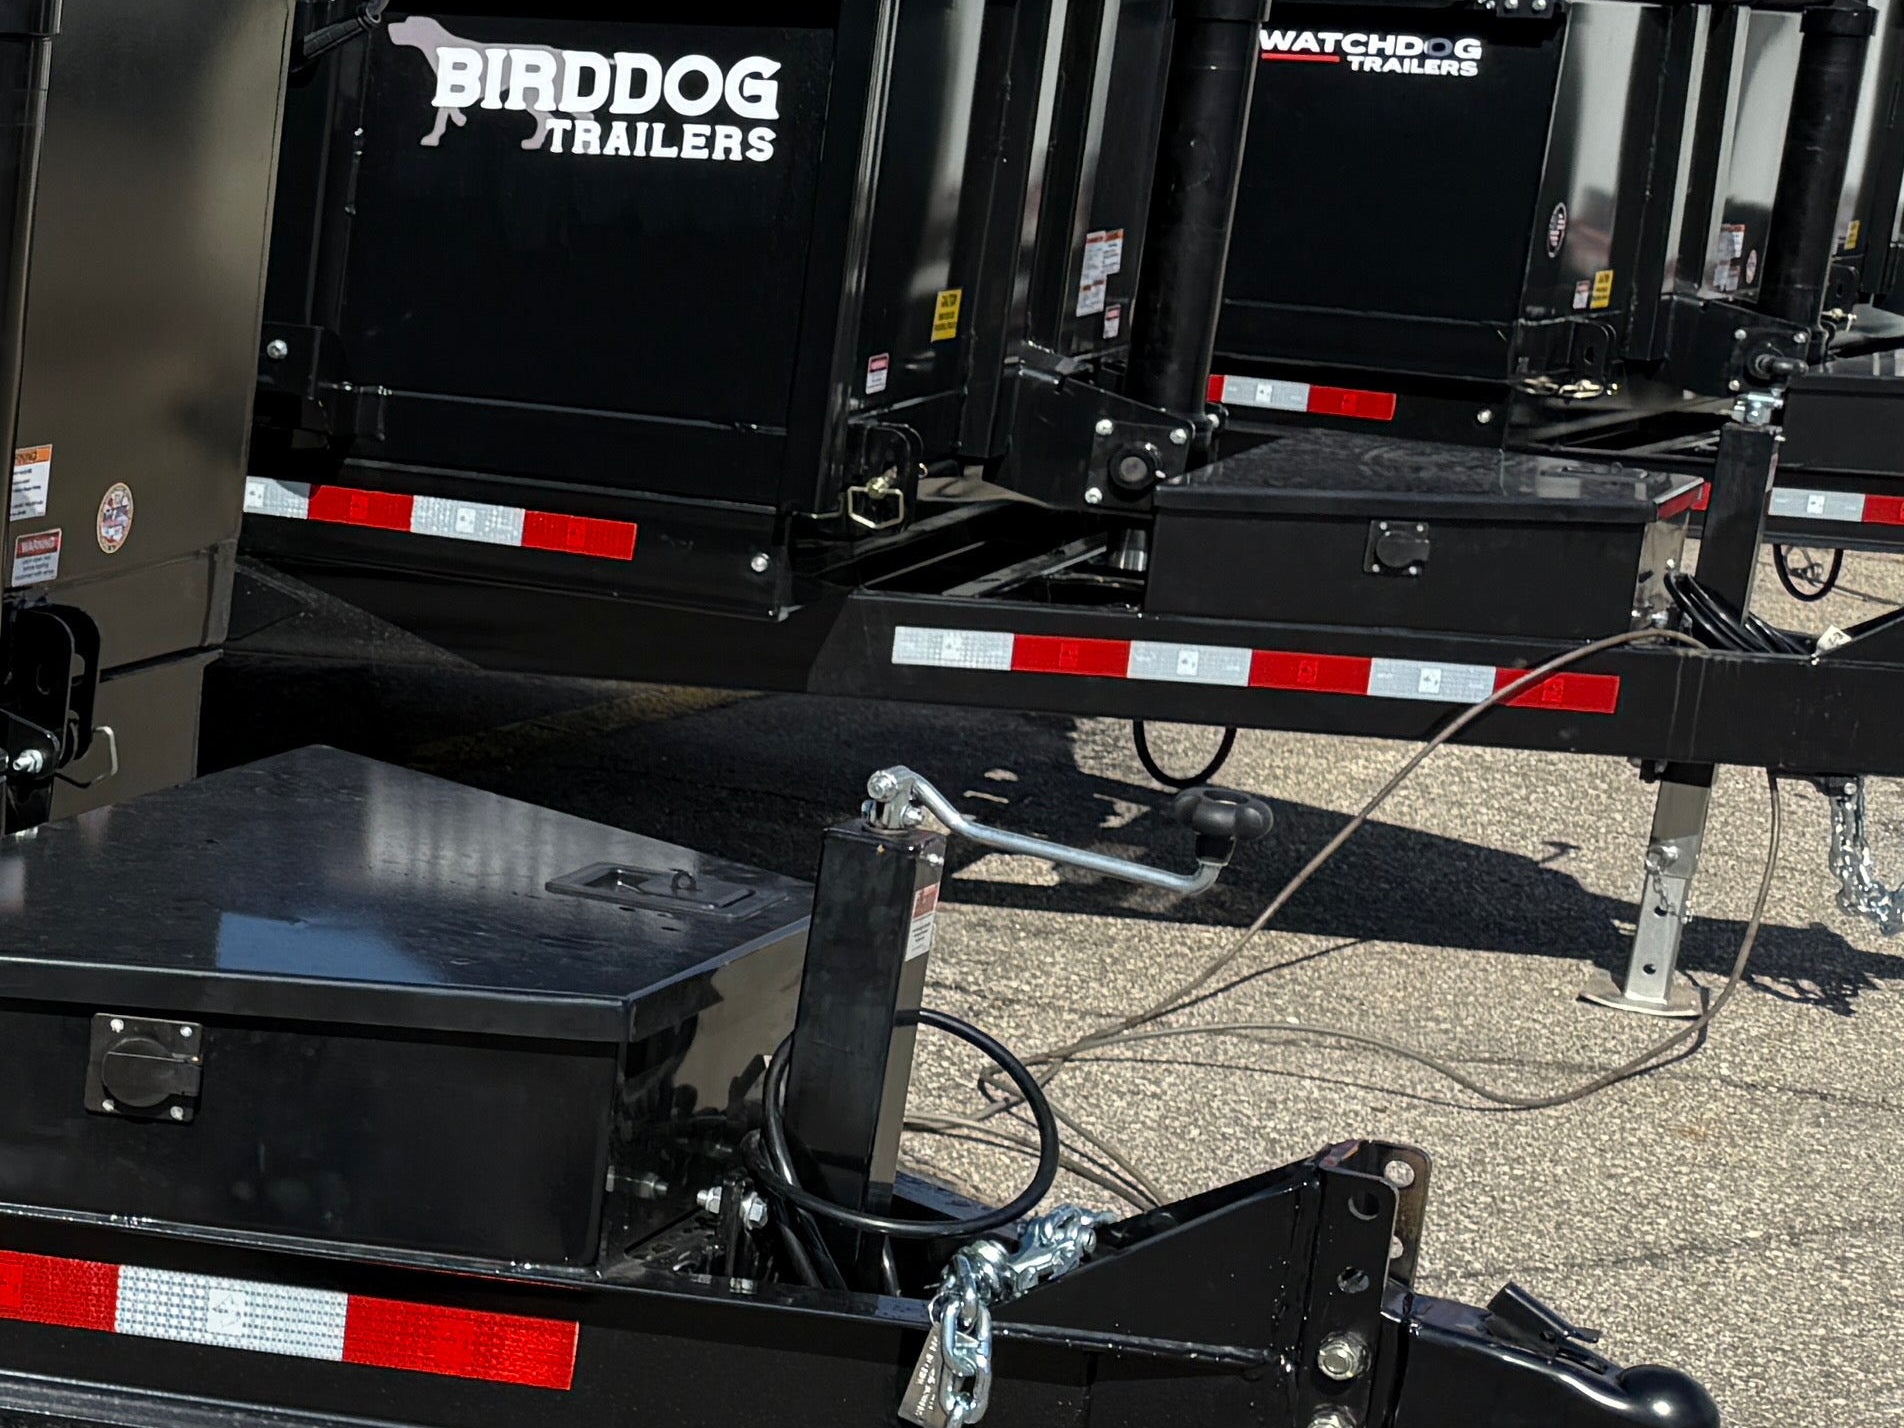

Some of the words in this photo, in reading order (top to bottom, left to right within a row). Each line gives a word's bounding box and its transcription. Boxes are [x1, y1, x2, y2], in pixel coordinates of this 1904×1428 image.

[1258, 29, 1483, 60] WATCHDOG
[430, 46, 782, 121] BIRDDOG
[1346, 55, 1479, 77] TRAILERS
[545, 118, 777, 162] TRAILERS
